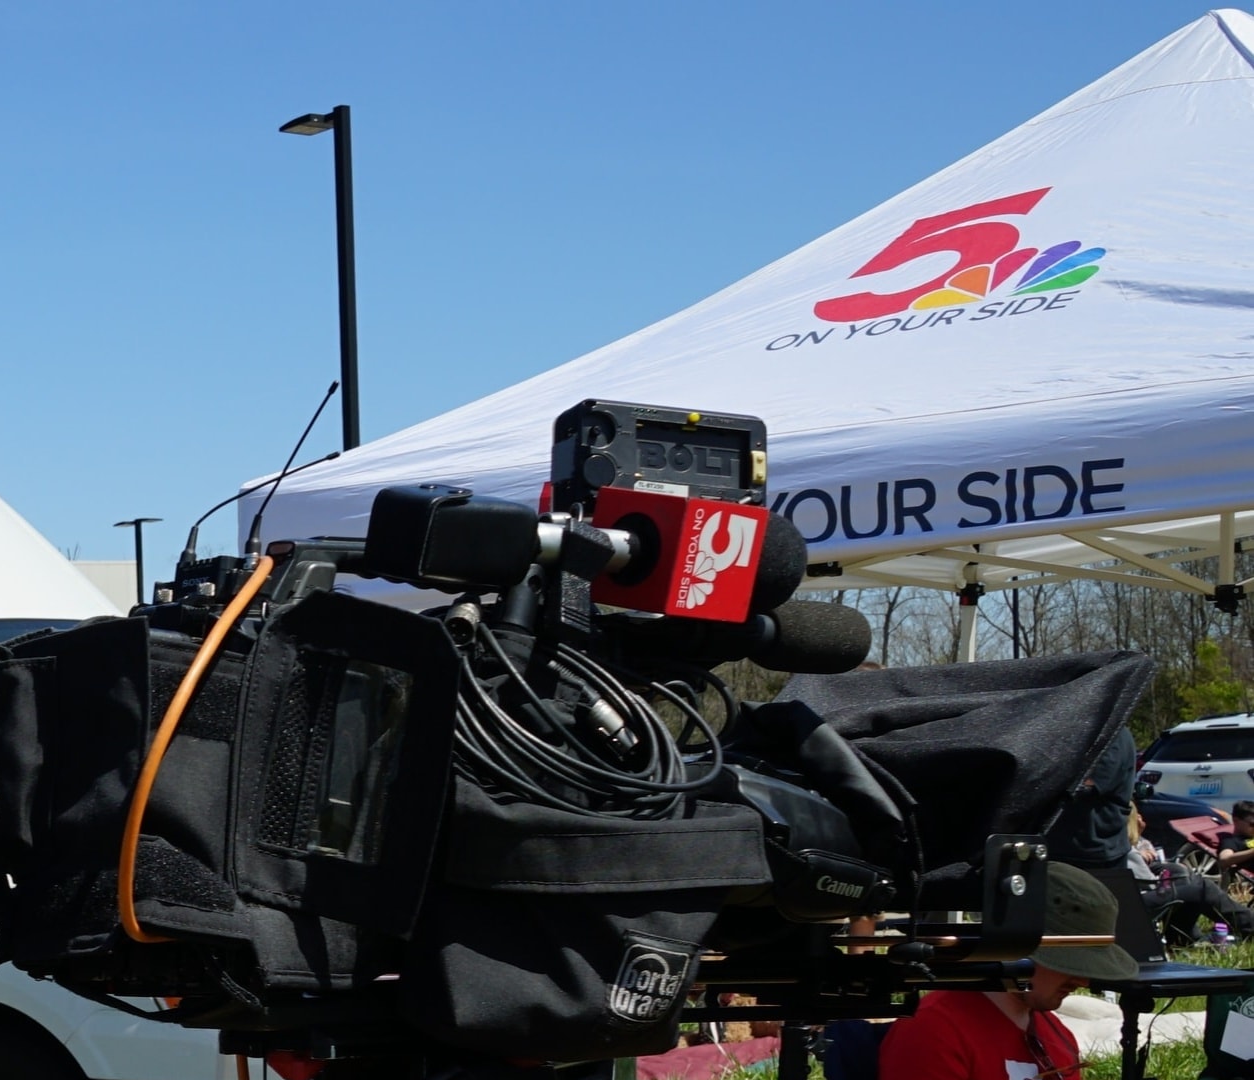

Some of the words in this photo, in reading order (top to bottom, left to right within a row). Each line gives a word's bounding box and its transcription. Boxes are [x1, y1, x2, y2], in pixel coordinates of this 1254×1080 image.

[814, 186, 1054, 322] 5
[765, 328, 835, 351] ON
[844, 307, 965, 340] YOUR
[969, 290, 1081, 321] SIDE
[638, 441, 740, 477] BOLT
[956, 457, 1126, 529] SIDE
[691, 508, 705, 531] ON
[683, 534, 700, 574] YOUR
[698, 510, 759, 573] 5
[675, 577, 691, 608] SIDE
[816, 875, 865, 898] Canon
